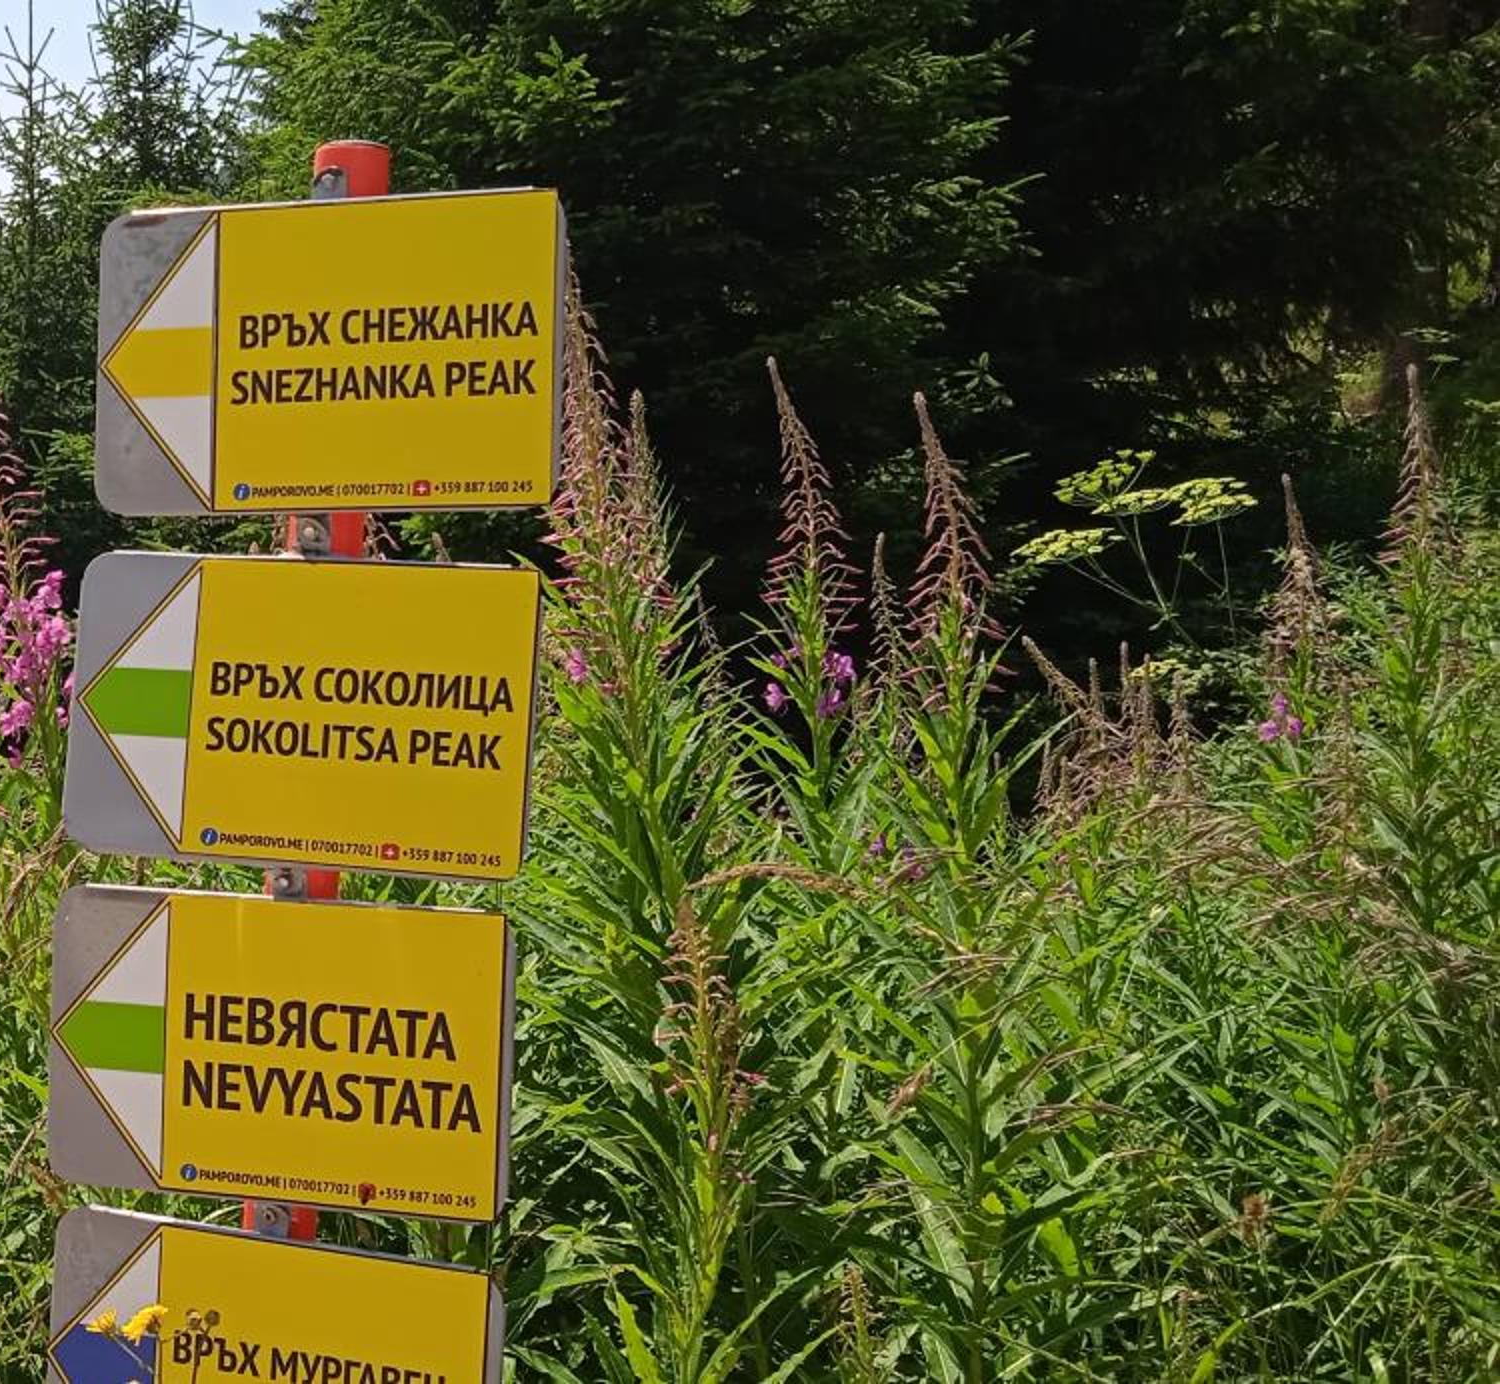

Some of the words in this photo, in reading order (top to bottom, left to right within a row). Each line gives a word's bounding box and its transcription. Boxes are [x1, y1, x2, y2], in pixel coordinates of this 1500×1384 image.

[239, 311, 331, 349] ВРЪХ
[341, 301, 539, 344] СНЕЖАНКА
[230, 363, 435, 405] SNEZHANKA
[445, 359, 536, 397] PEAK
[252, 484, 334, 498] PAMPOROVO.ME
[342, 483, 404, 496] 070017702
[464, 481, 485, 493] 887
[488, 481, 509, 493] 100
[511, 480, 533, 493] 245
[210, 661, 305, 700] ВРЪХ
[313, 667, 514, 717] СОКОЛИЦА
[205, 717, 399, 764] SOKOLITSA
[408, 729, 502, 770] PEAK
[219, 833, 303, 850] PAMPOROVO.ME
[311, 839, 373, 857] 070017702
[432, 850, 454, 862] 887
[456, 853, 478, 865] 100
[480, 854, 501, 867] 245
[184, 993, 457, 1061] НЕВЯСТАТА
[182, 1059, 482, 1133] NEVYASTATA
[200, 1169, 282, 1189] PAMPOROVO.ME
[288, 1178, 349, 1196] 070017702
[408, 1189, 429, 1203] 887
[431, 1192, 453, 1205] 100
[455, 1194, 477, 1208] 245
[172, 1332, 260, 1376] ВРЪХ
[270, 1347, 446, 1384] МУРГАВ
